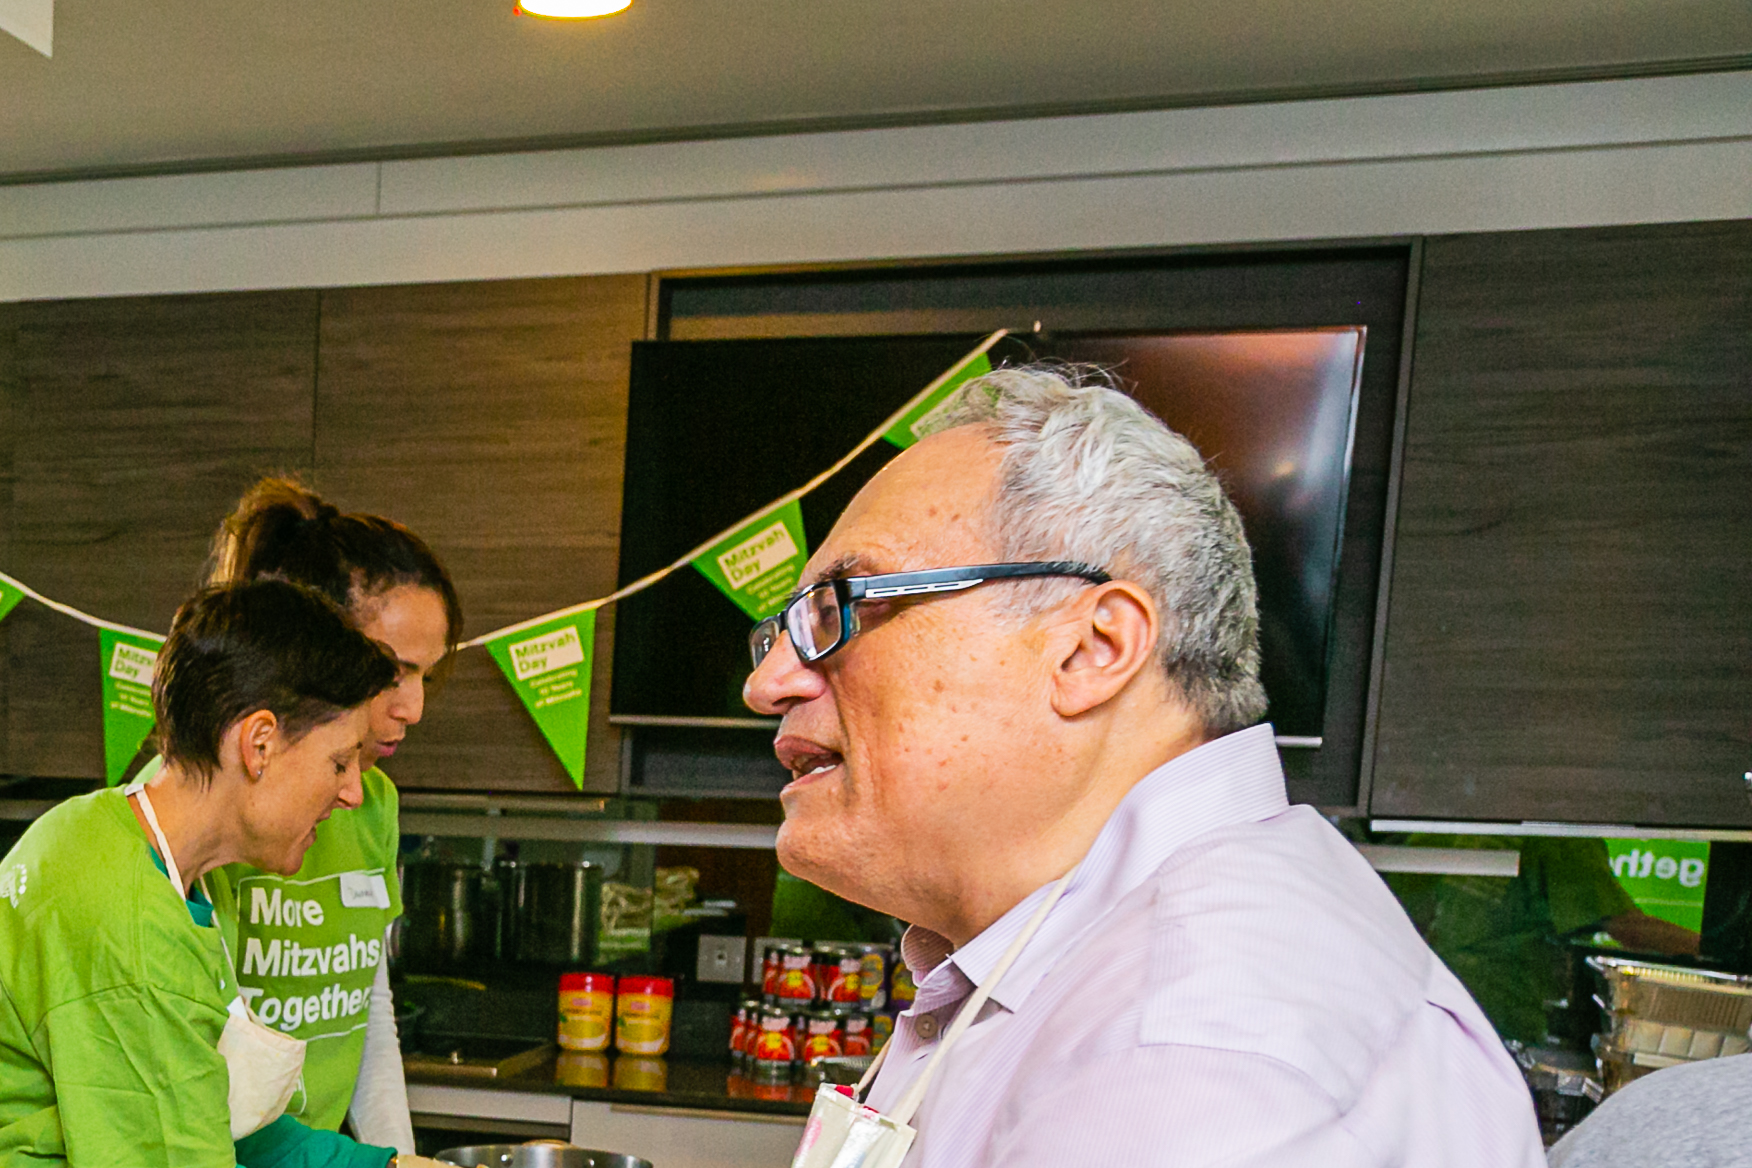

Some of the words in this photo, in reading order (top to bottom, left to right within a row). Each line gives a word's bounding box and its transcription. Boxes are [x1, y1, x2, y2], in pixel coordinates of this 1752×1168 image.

[724, 530, 785, 567] Mitzvah
[731, 559, 760, 581] Day
[515, 633, 576, 657] Mitzvah
[115, 660, 139, 678] Day
[518, 657, 548, 673] Day
[250, 886, 325, 928] More
[242, 933, 381, 977] Mitzvahs
